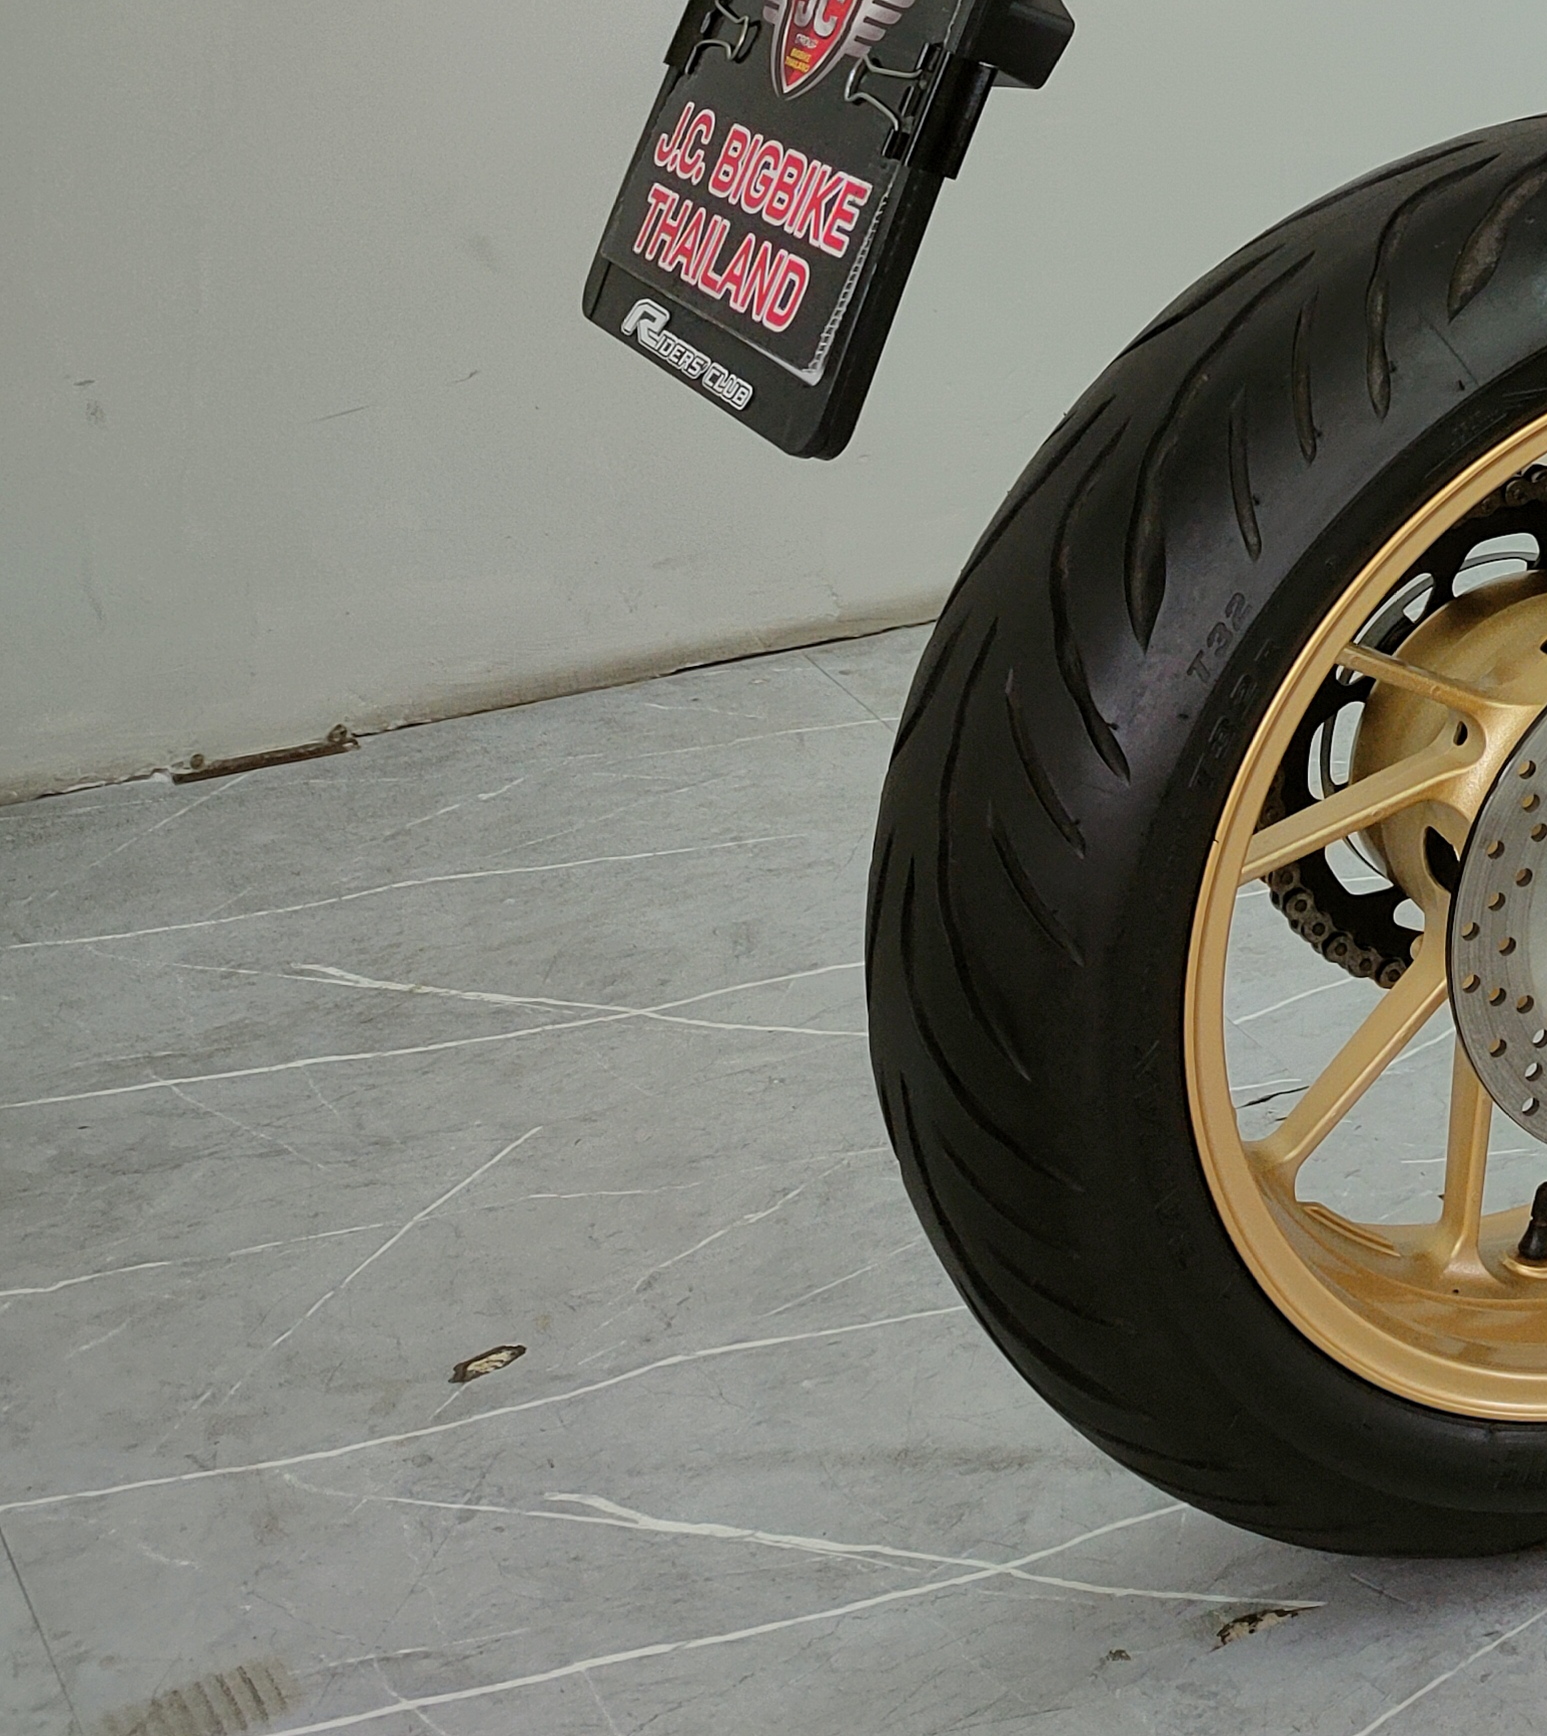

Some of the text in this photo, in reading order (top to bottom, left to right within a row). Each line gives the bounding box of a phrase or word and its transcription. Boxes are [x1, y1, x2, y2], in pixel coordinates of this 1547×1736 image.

[654, 101, 873, 258] J.C. BIGBIKE
[633, 182, 810, 333] THAILAND
[702, 361, 753, 411] CLUB
[1186, 592, 1252, 684] T32
